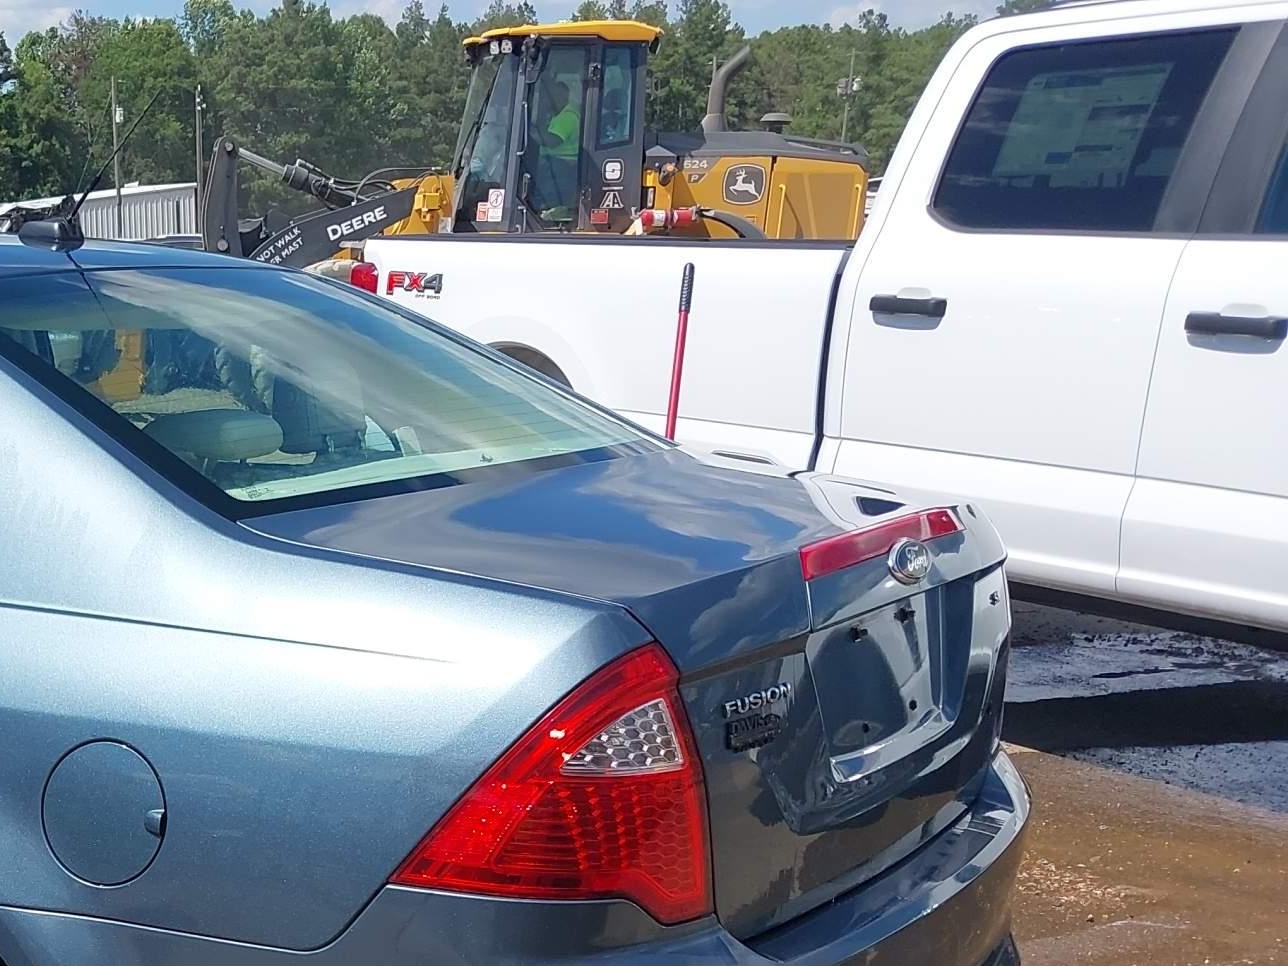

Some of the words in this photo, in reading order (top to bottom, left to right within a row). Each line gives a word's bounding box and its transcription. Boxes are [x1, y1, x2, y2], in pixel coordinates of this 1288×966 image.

[683, 159, 708, 169] 624
[690, 174, 699, 183] P
[326, 205, 388, 241] DEERE
[275, 226, 302, 249] WALK
[281, 237, 304, 258] MAST
[386, 271, 443, 295] FX4
[905, 545, 928, 572] Ford
[724, 682, 793, 719] FUSION
